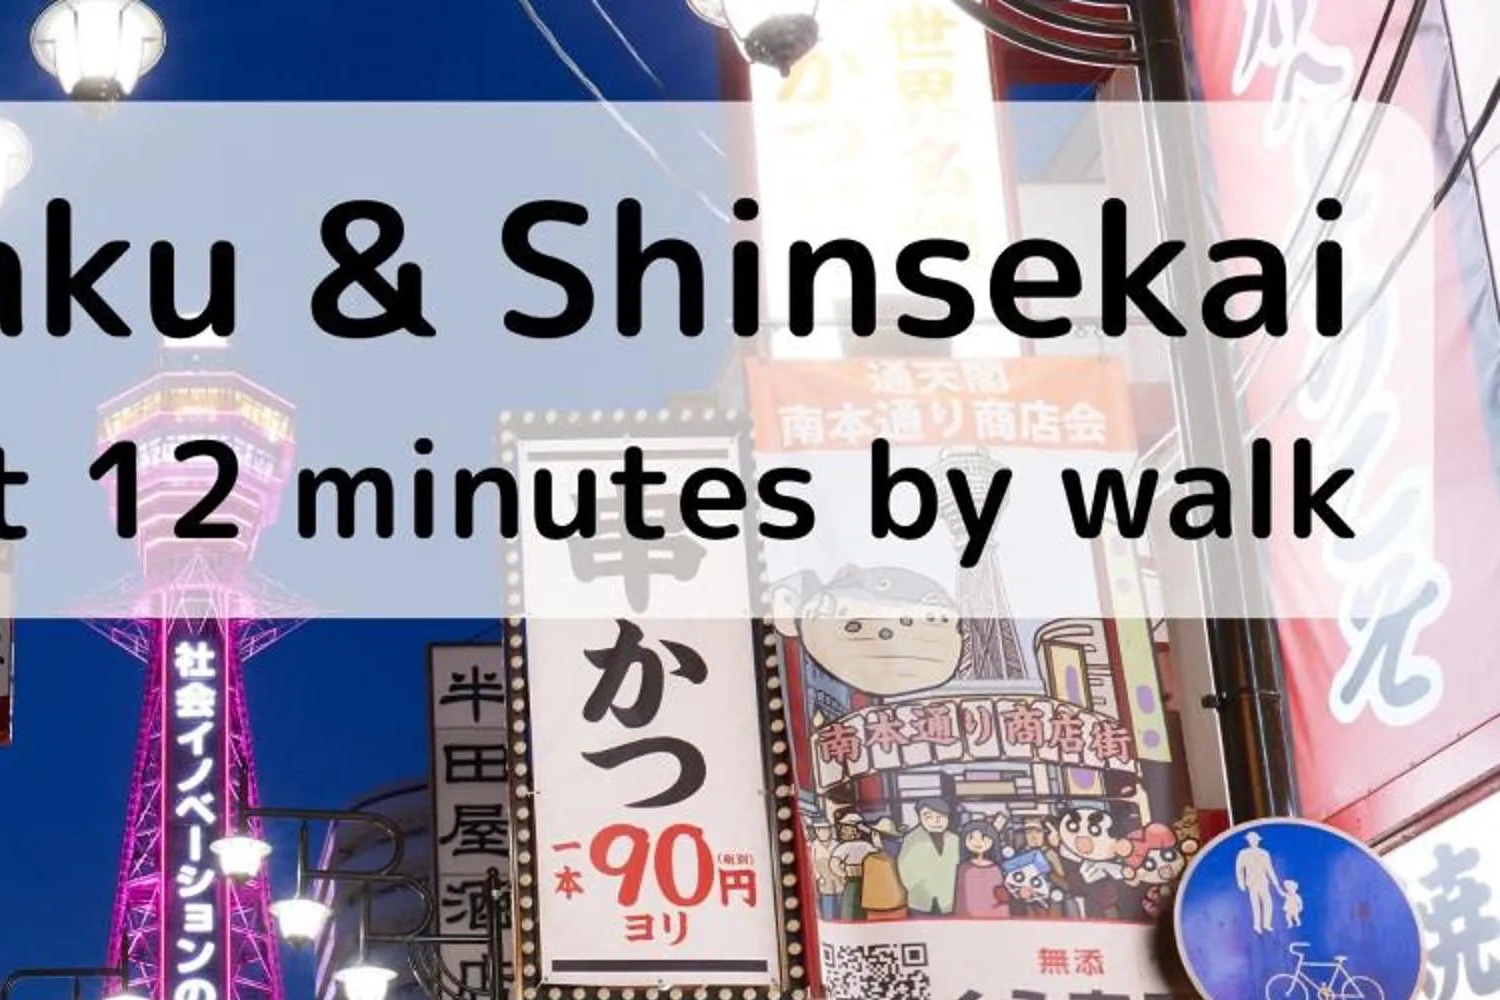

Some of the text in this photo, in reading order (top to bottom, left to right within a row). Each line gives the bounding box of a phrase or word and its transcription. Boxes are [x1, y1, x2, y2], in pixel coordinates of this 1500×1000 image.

[778, 402, 1108, 445] 南本通り商店会
[566, 490, 709, 810] 串かつ
[817, 703, 1134, 768] 南本通り商店街
[624, 912, 689, 946] ヨリ
